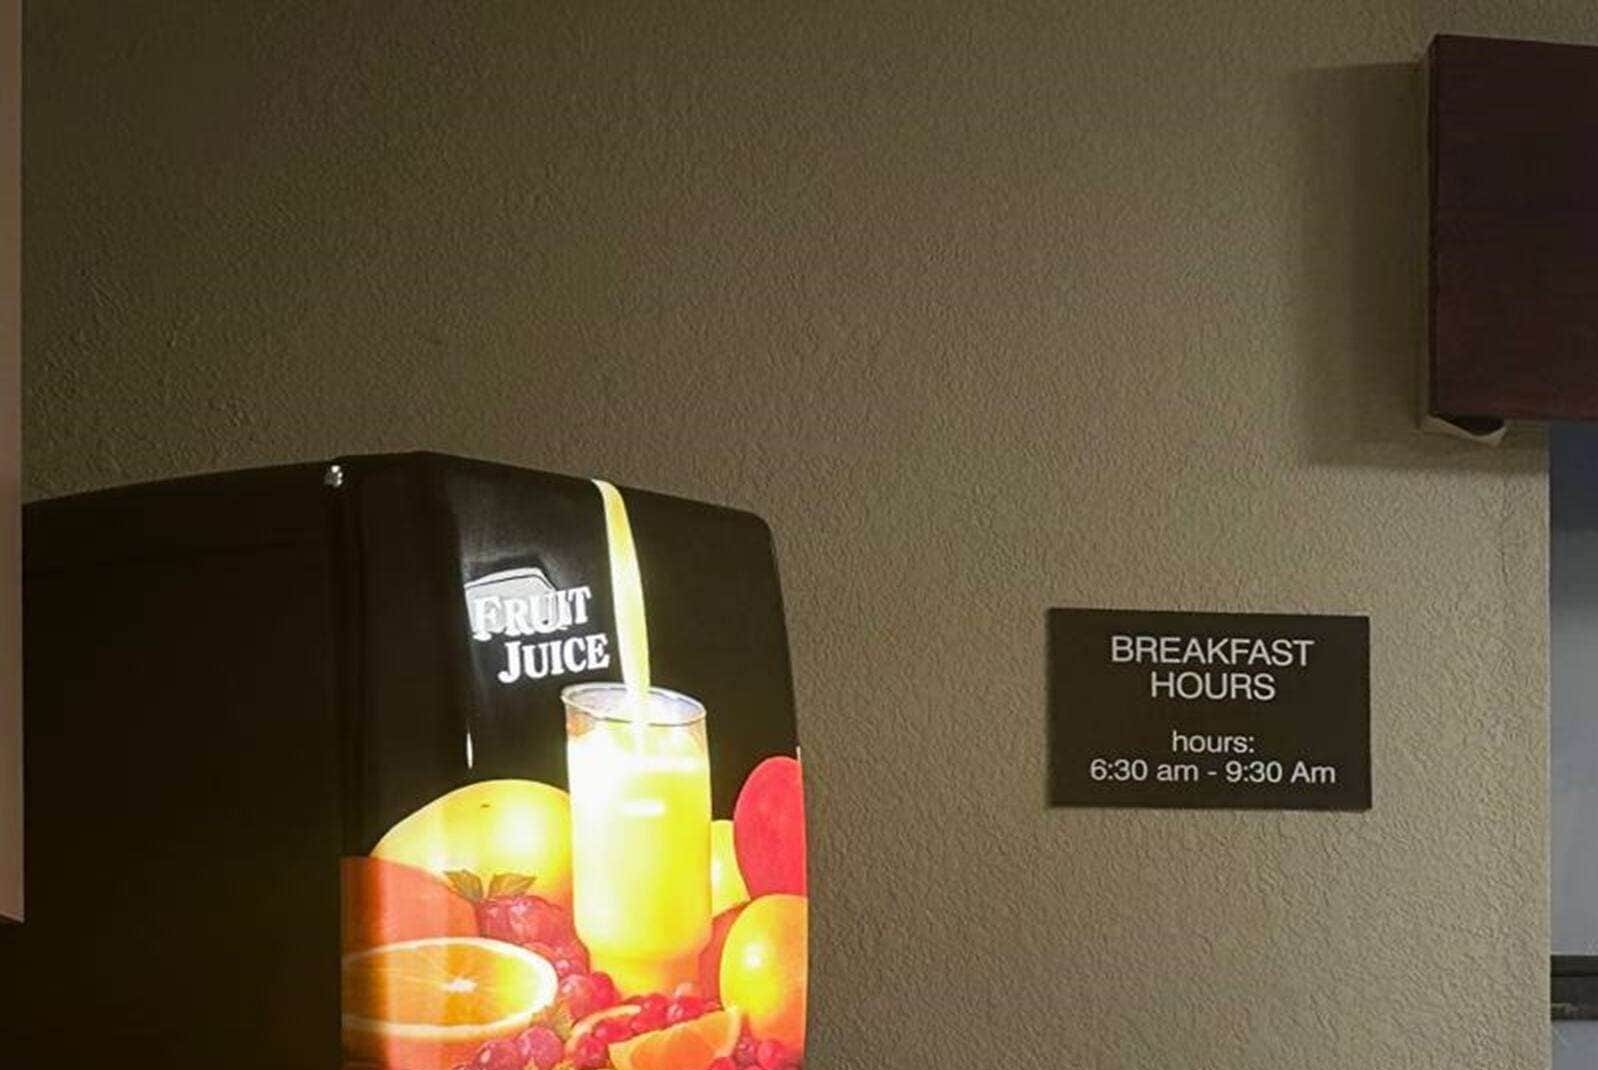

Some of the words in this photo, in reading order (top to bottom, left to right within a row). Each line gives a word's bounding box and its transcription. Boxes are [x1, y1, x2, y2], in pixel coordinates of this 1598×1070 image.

[473, 586, 592, 641] FRUIT
[497, 633, 611, 683] JUICE
[1111, 636, 1315, 666] BREAKFAST
[1150, 671, 1276, 700] HOURS
[1172, 730, 1255, 753] hours:
[1090, 759, 1148, 781] 6:30
[1156, 764, 1199, 782] am
[1225, 761, 1283, 783] 9:30
[1290, 761, 1336, 783] Am
